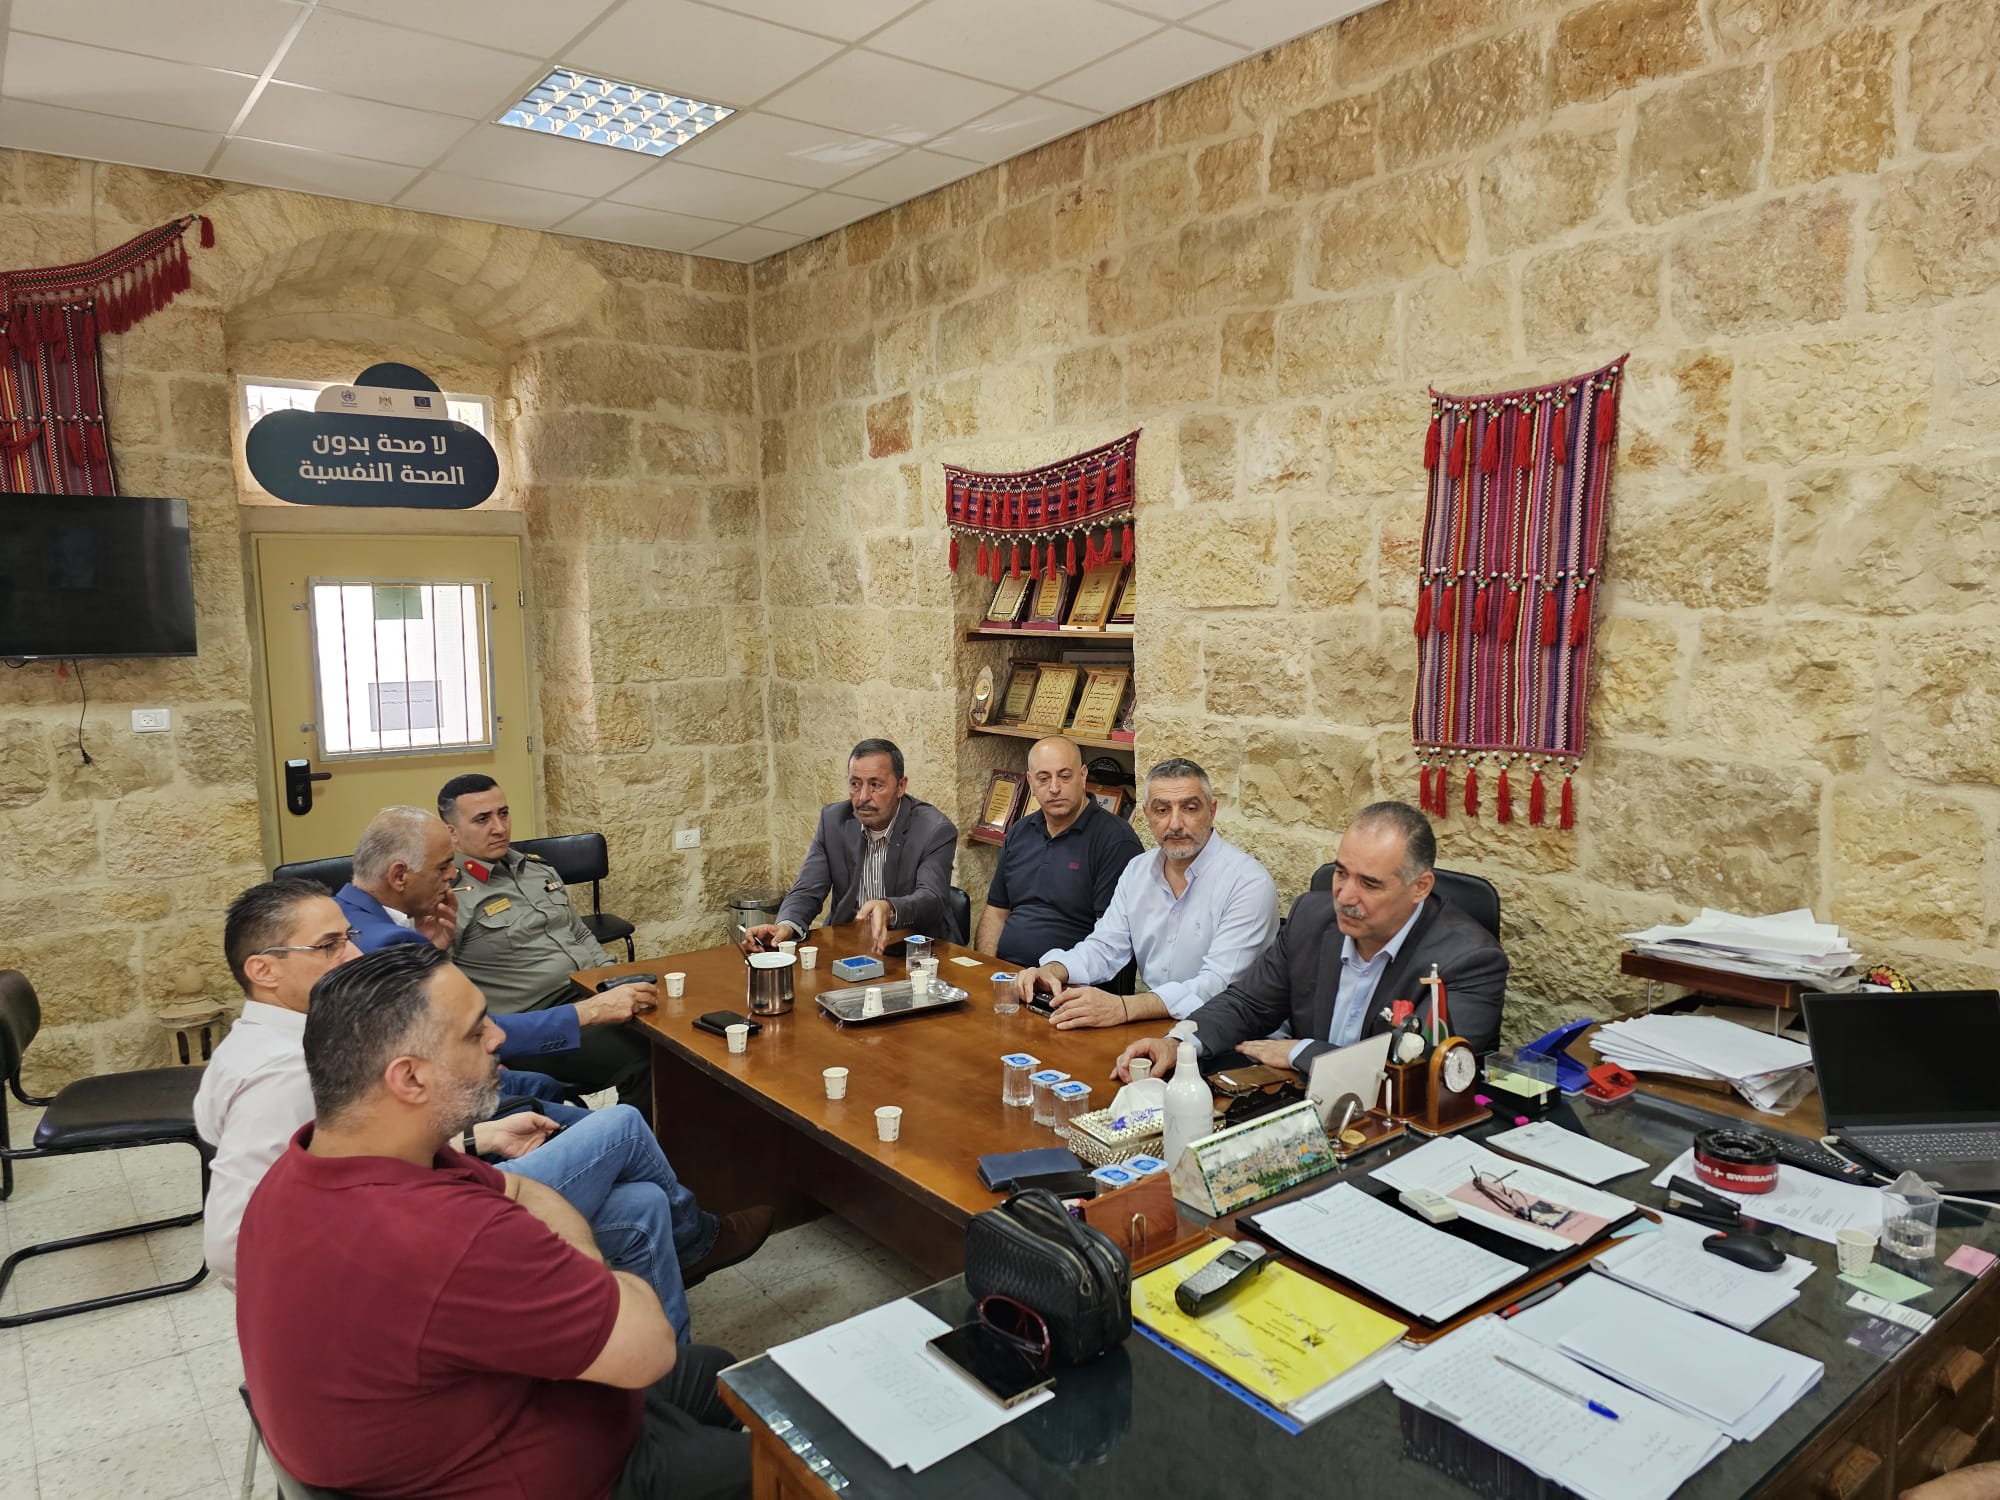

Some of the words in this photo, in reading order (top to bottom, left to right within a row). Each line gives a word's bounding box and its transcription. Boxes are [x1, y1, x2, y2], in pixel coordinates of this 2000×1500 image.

[312, 434, 370, 456] بدون
[376, 433, 426, 454] صحة
[431, 435, 448, 455] لا
[298, 459, 394, 484] النفسية
[400, 465, 465, 485] الصحة
